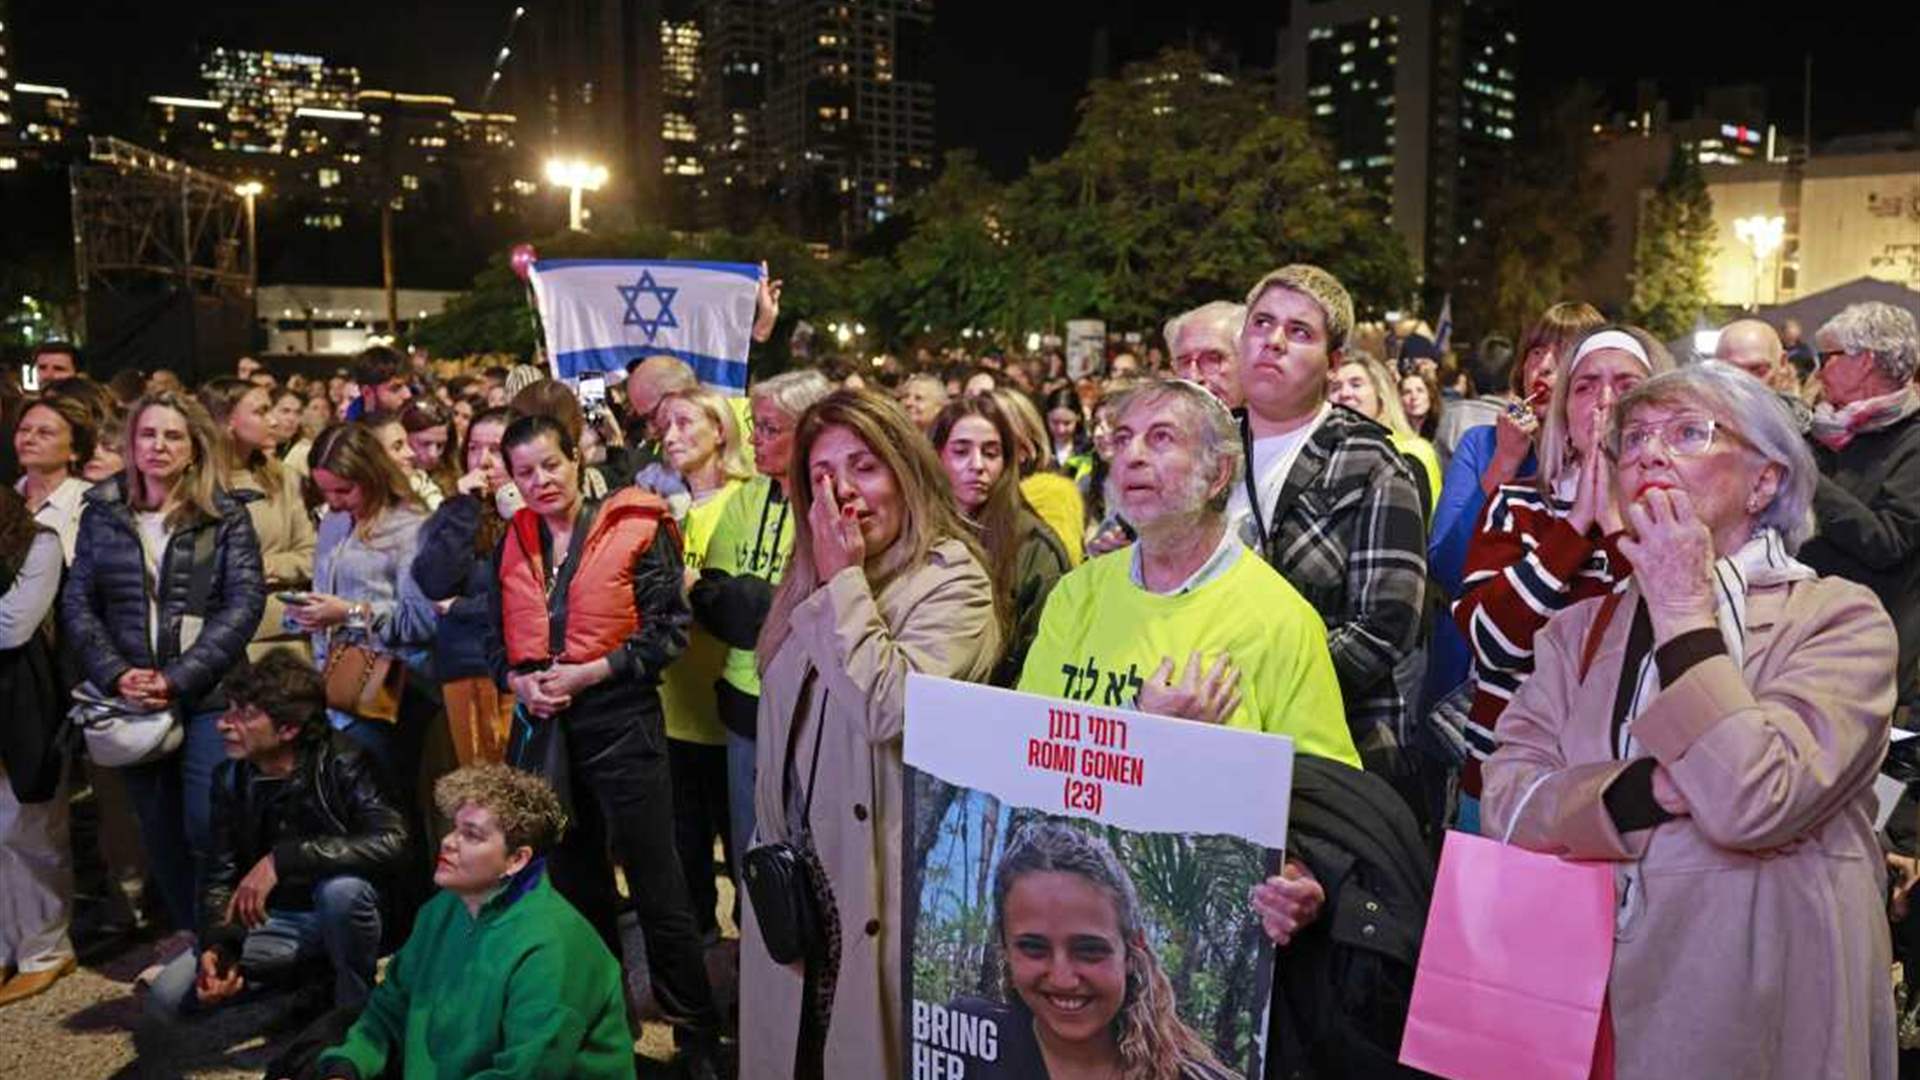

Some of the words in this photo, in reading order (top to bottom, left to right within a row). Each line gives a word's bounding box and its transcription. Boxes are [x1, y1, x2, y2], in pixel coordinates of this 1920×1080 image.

[1104, 663, 1143, 707] לא
[1049, 708, 1080, 741] גונן
[1088, 715, 1127, 750] רומי
[1028, 738, 1076, 775] ROMI
[1081, 748, 1144, 787] GONEN
[1064, 777, 1102, 815] (23)
[913, 998, 998, 1061] BRING
[913, 1041, 965, 1080] HER
